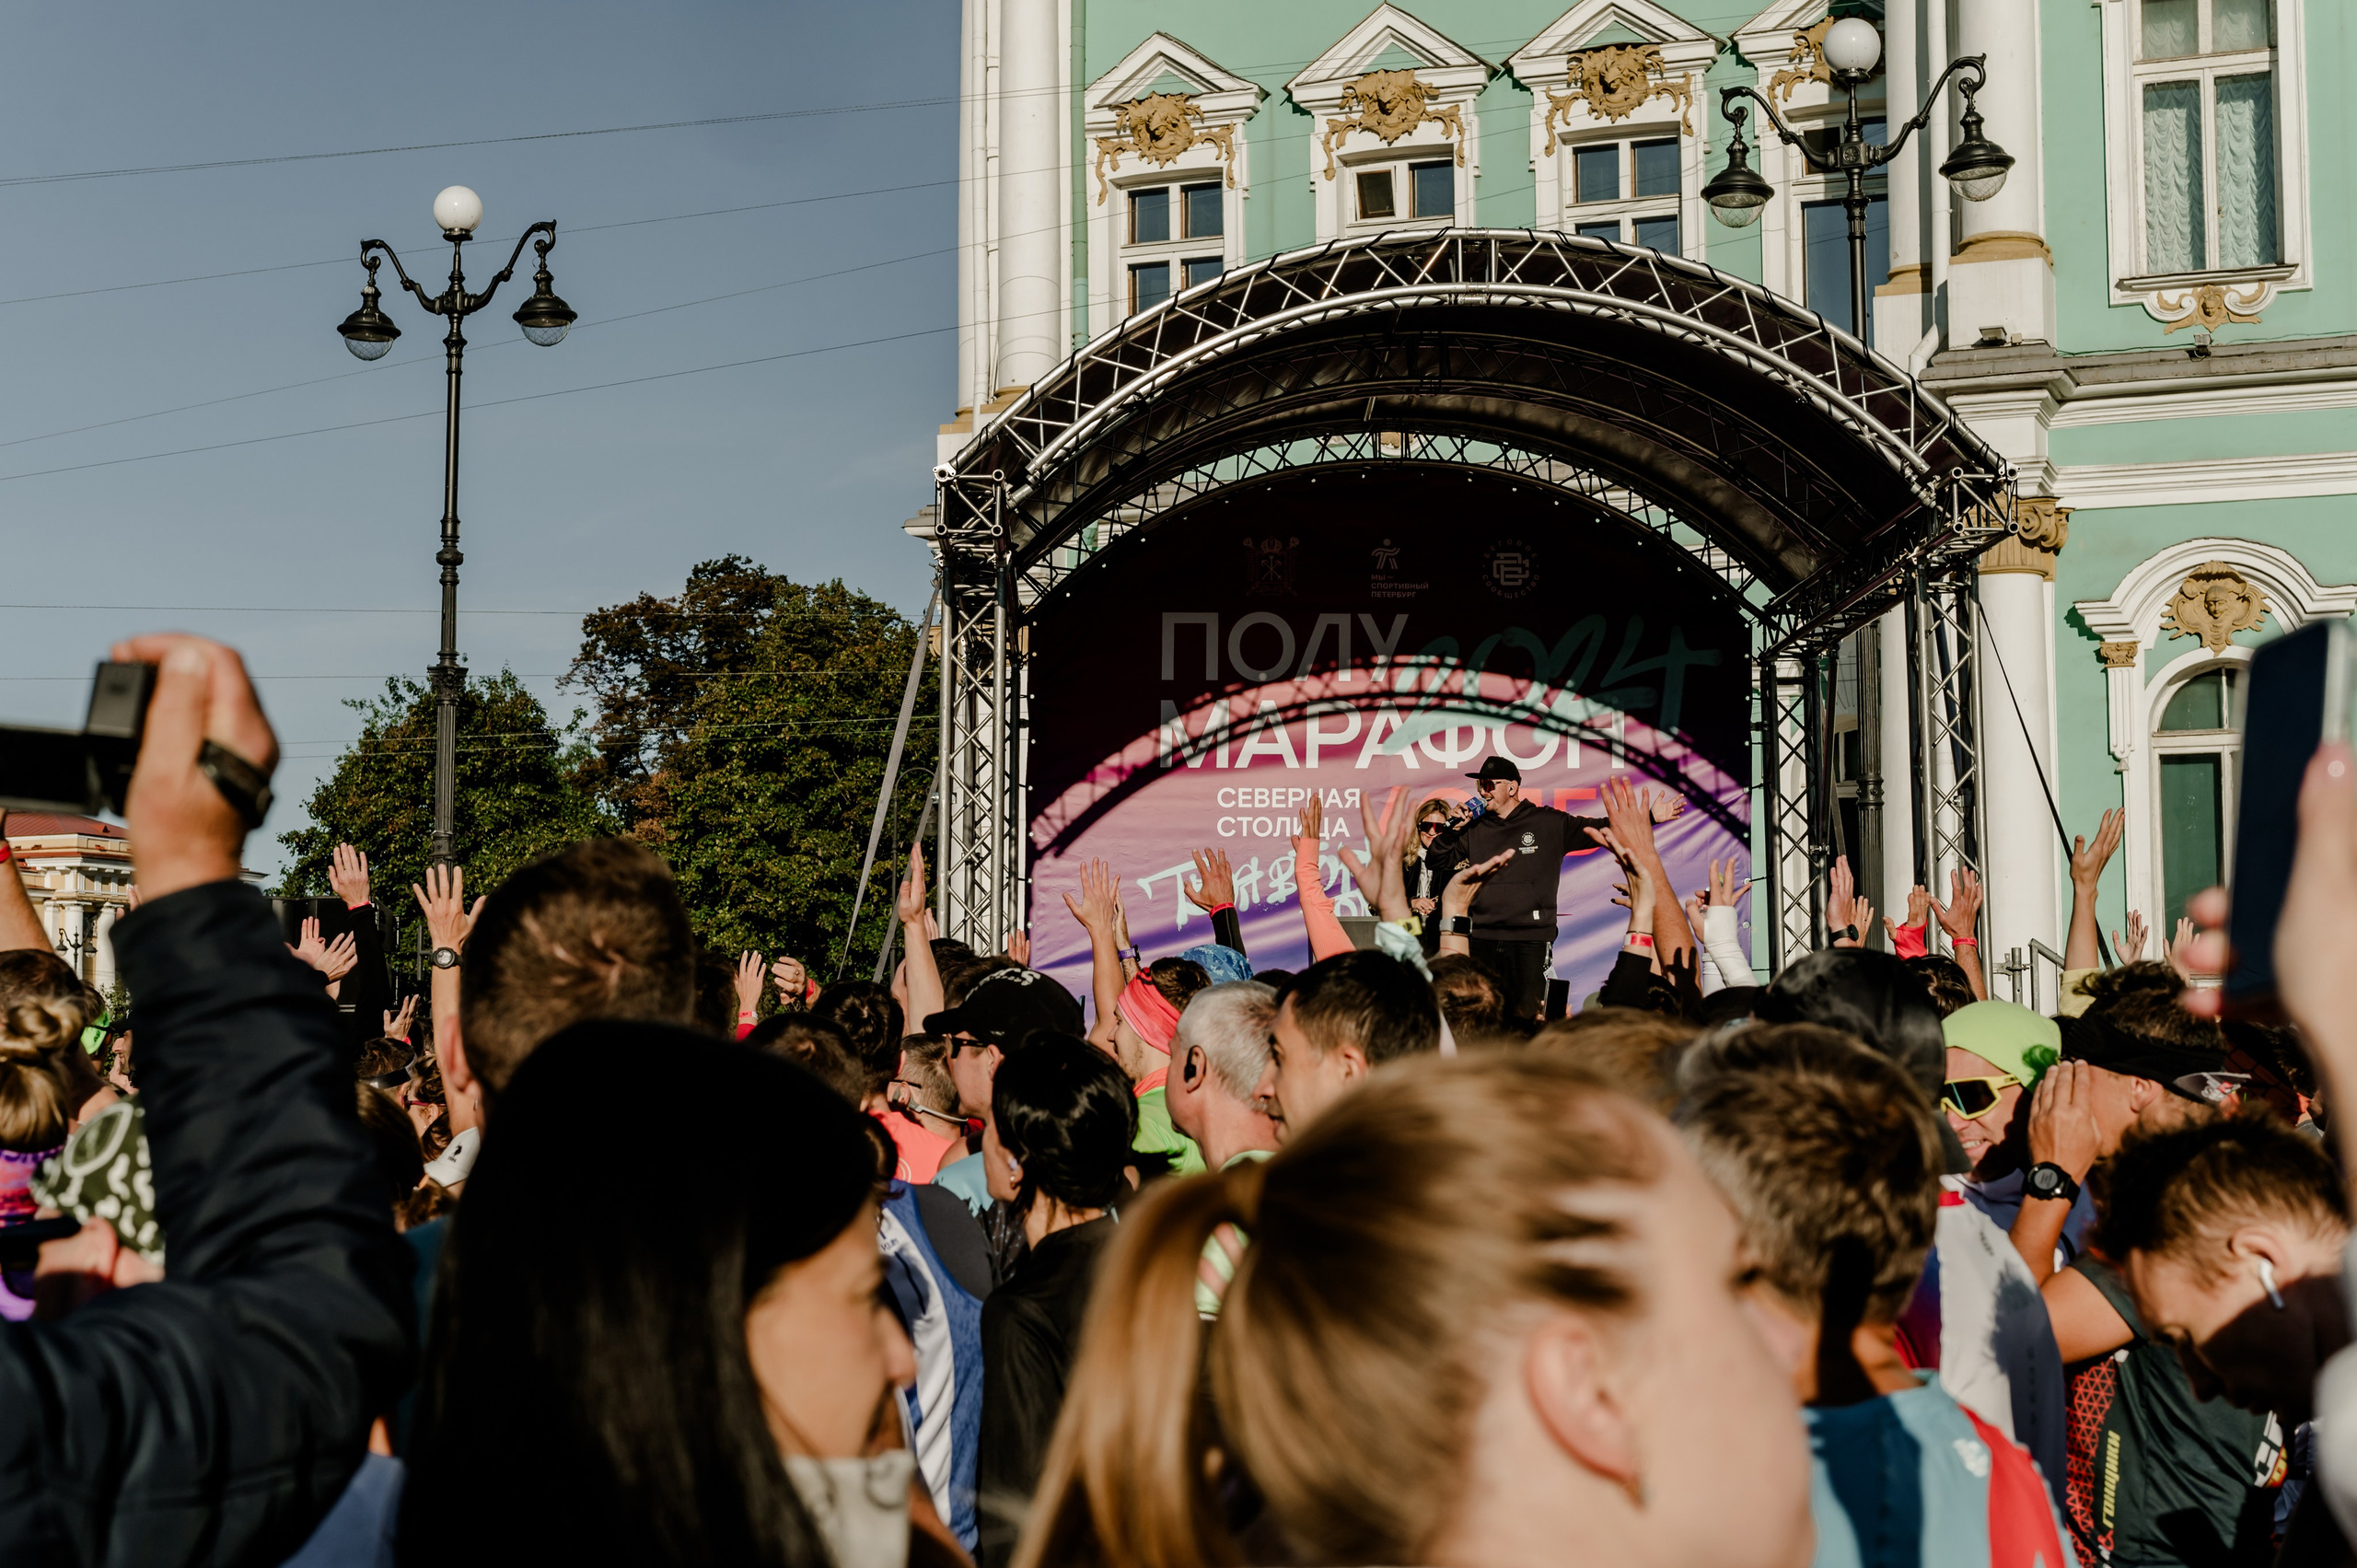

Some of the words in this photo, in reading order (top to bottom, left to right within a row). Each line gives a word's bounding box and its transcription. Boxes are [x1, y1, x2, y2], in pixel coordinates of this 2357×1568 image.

[1371, 581, 1430, 589] СПОРТИВНЫЙ
[1161, 611, 1410, 682] ПОЛУ
[1382, 613, 1724, 755] 2024
[1160, 698, 1625, 770] МАРАФОН
